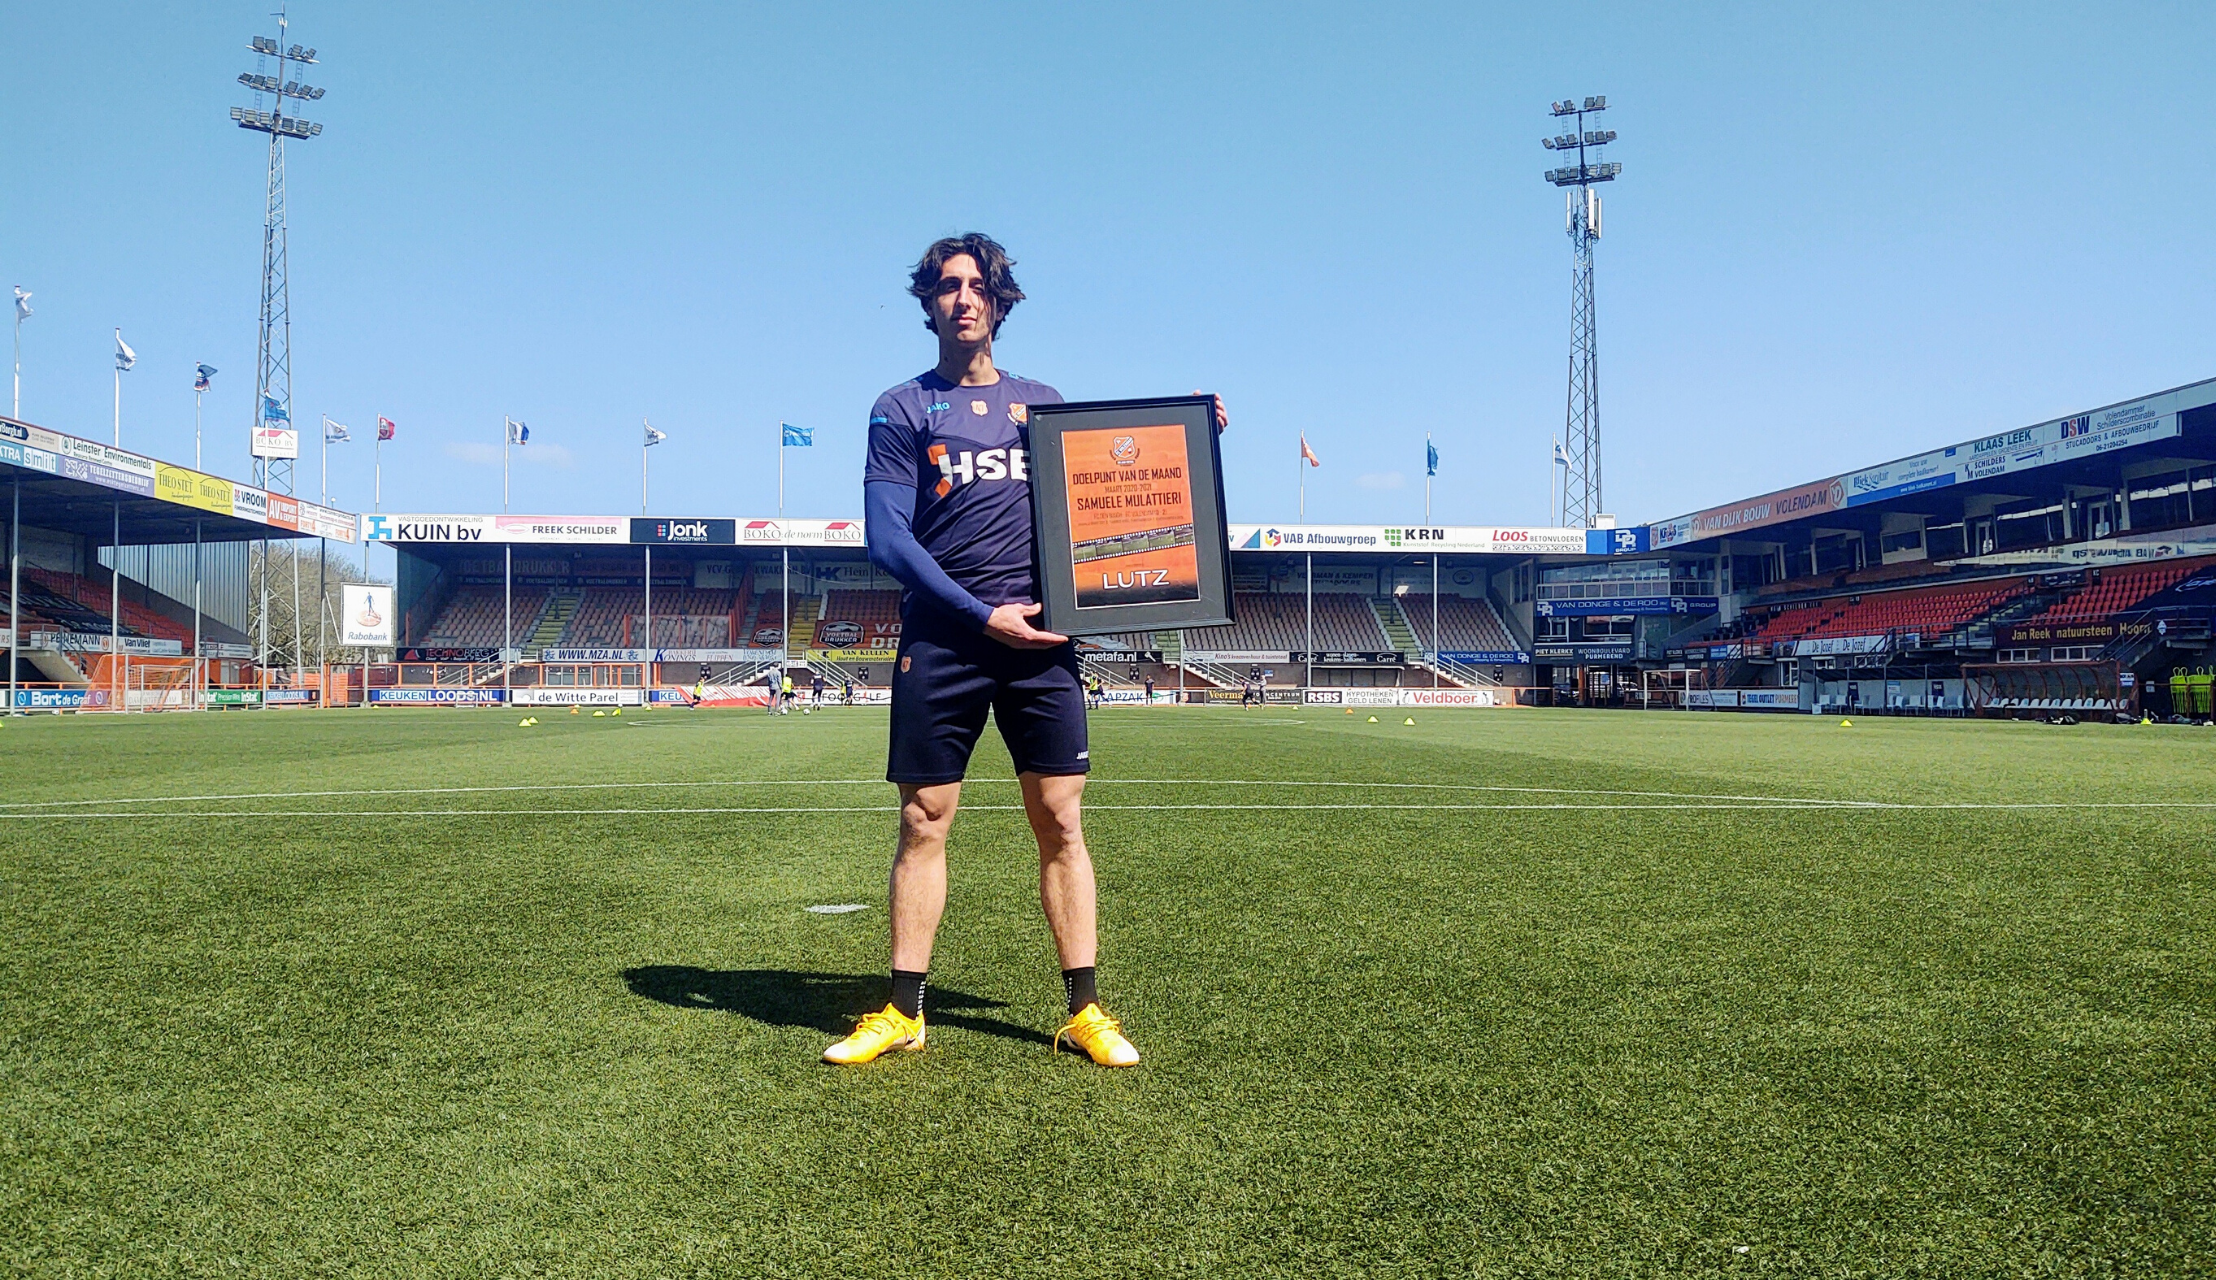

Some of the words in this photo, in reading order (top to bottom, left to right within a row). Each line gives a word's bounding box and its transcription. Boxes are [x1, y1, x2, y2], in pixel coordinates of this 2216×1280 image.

[2061, 416, 2090, 440] DSW
[1974, 438, 2004, 453] KLAAS
[2008, 430, 2032, 445] LEEK
[73, 438, 101, 456] Leinster
[104, 446, 152, 470] Environmentals
[1974, 456, 2006, 469] SCHILDERS
[1072, 470, 1116, 485] DOELPUNT
[1118, 470, 1136, 482] VAN
[1138, 468, 1150, 480] DE
[1152, 467, 1182, 480] MAAND
[1974, 466, 2005, 478] VOLENDAM
[159, 474, 176, 489] THEO
[178, 480, 193, 493] STET
[200, 484, 216, 498] THEO
[216, 488, 230, 502] STET
[241, 491, 266, 508] VROOM
[1078, 496, 1122, 510] SAMUELE
[1126, 492, 1182, 508] MULATTIERI
[1704, 517, 1721, 531] VAN
[1722, 512, 1742, 528] DIJK
[1743, 503, 1772, 524] BOUW
[1776, 490, 1828, 514] VOLENDAM
[398, 524, 450, 540] KUIN
[457, 524, 482, 540] bv
[532, 525, 564, 534] FREEK
[566, 525, 618, 536] SCHILDER
[824, 530, 861, 540] BOKO
[1405, 529, 1444, 540] KRN
[1492, 530, 1528, 542] LOOS
[1284, 533, 1304, 544] VAB
[1306, 533, 1376, 546] Afbouwgroep
[844, 566, 868, 576] Hein
[1102, 569, 1170, 590] LUTZ
[348, 632, 388, 642] Rabobank
[2012, 628, 2028, 641] Jan
[2030, 628, 2050, 640] Reek
[2056, 626, 2112, 640] natuursteen
[558, 650, 624, 660] WWW.MZA.NL
[1085, 652, 1137, 662] metafa.nl
[538, 692, 552, 702] de
[556, 692, 586, 702] Witte
[590, 692, 618, 702] Parel
[1308, 692, 1340, 702] RSBS
[1413, 692, 1478, 704] Veldboer
[1758, 694, 1774, 704] OUTLET
